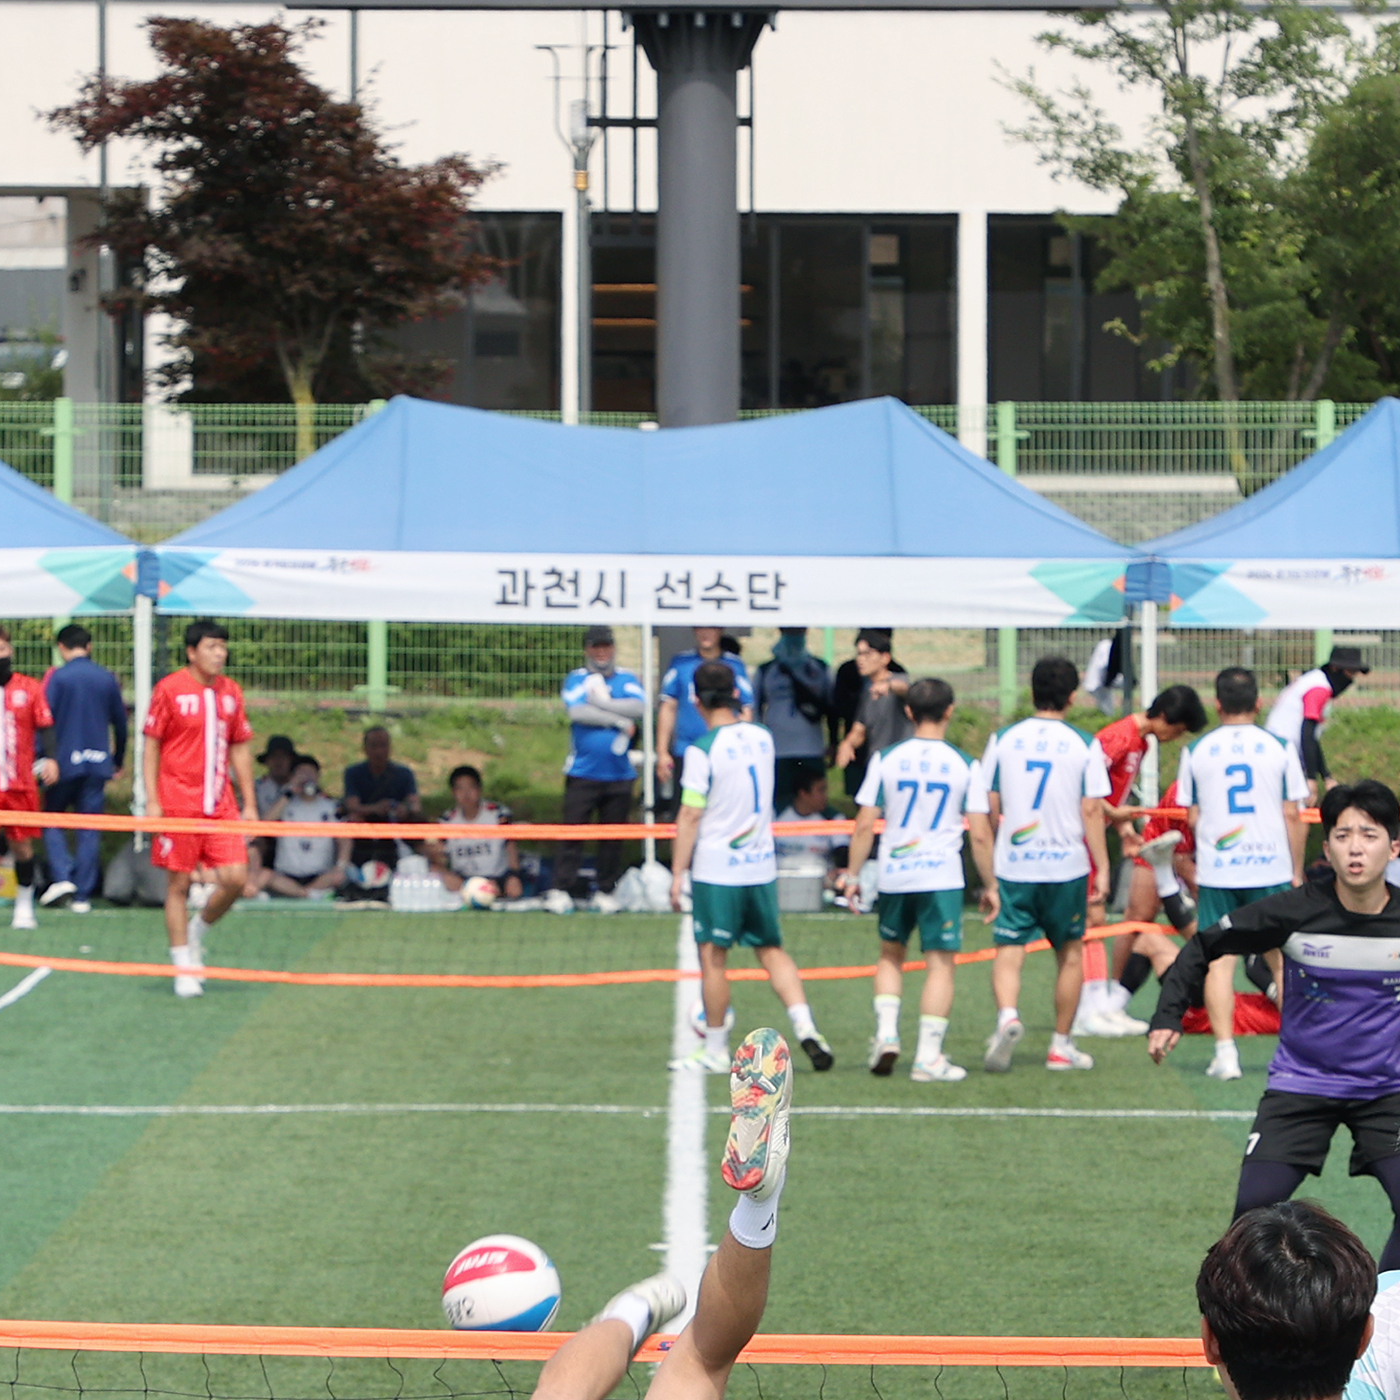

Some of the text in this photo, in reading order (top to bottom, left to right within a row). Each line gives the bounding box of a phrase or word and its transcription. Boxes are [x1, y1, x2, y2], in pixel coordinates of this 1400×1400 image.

[495, 567, 787, 611] 과천시 선수단
[748, 764, 761, 814] 1
[897, 780, 951, 831] 77
[1025, 760, 1053, 811] 7
[1225, 763, 1255, 815] 2
